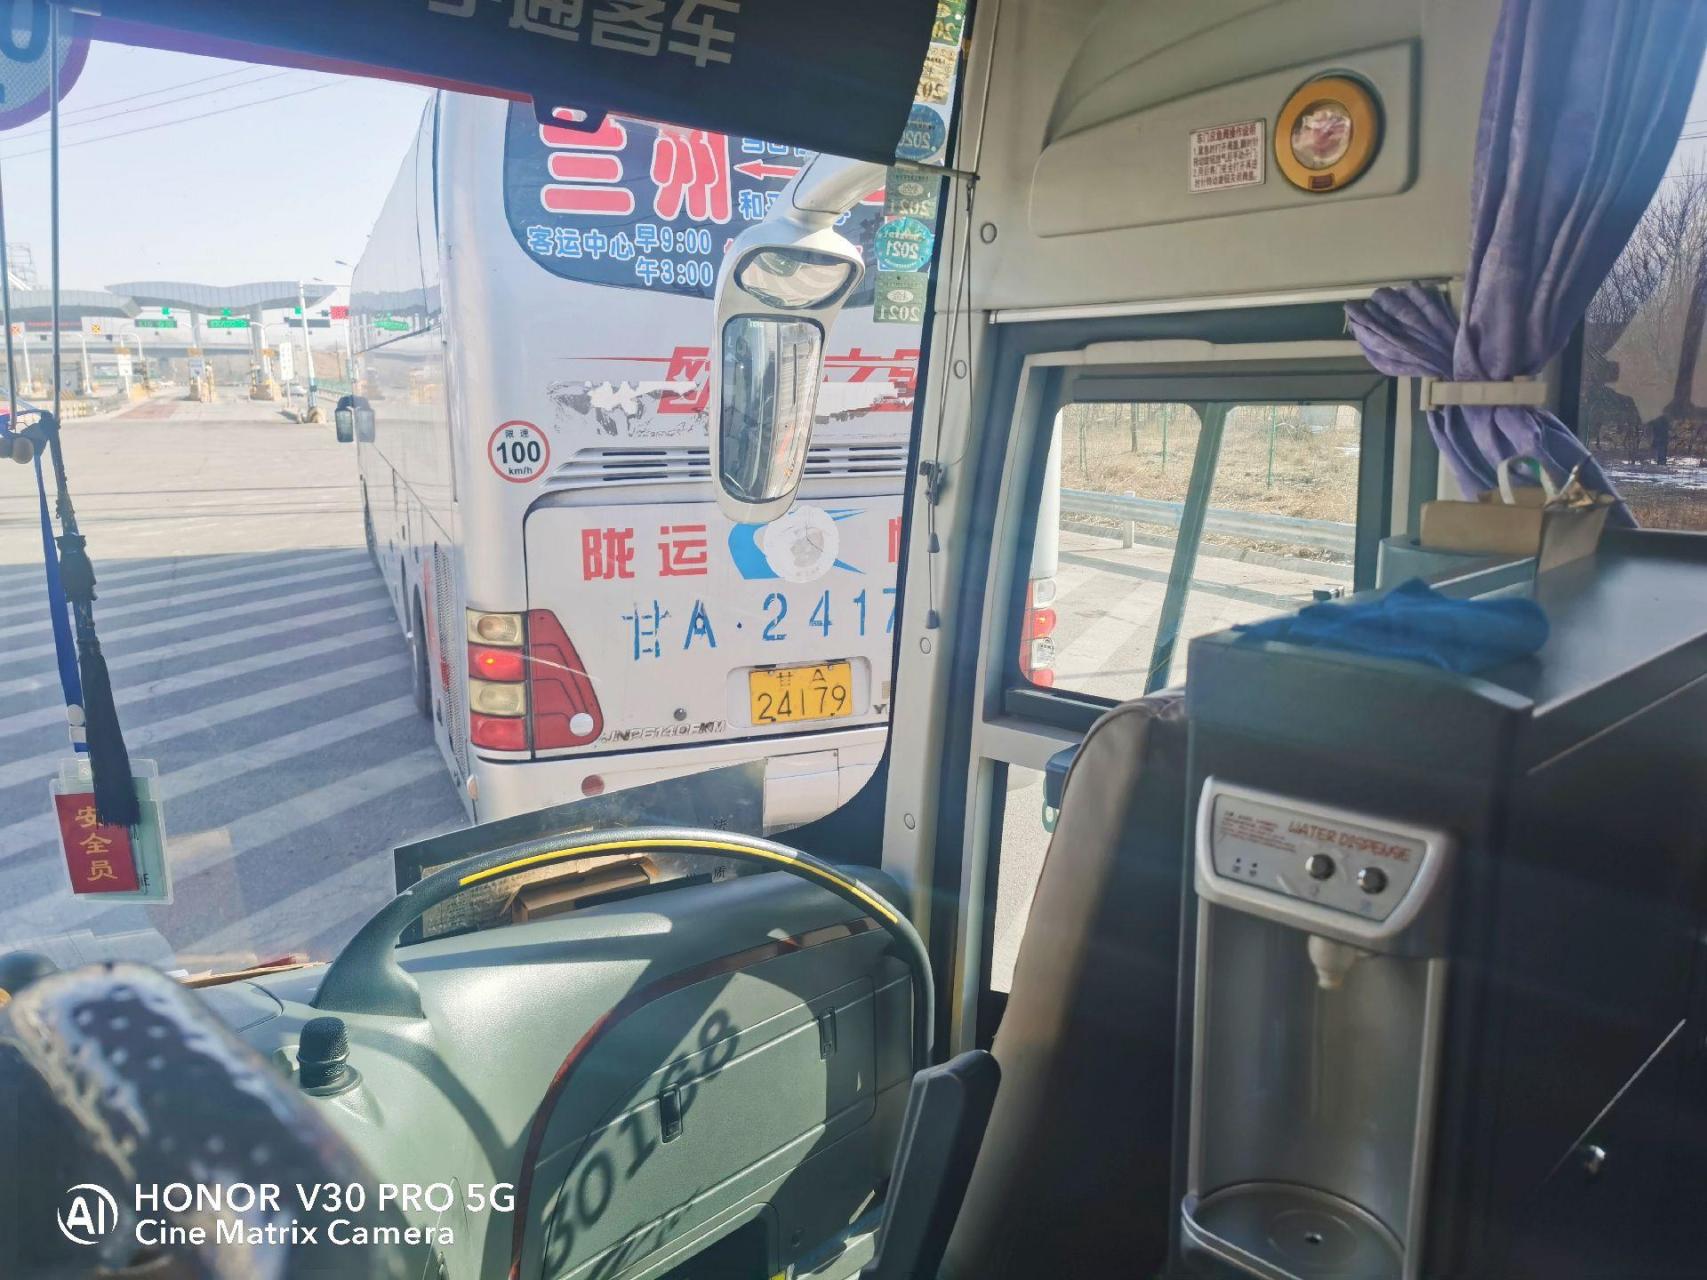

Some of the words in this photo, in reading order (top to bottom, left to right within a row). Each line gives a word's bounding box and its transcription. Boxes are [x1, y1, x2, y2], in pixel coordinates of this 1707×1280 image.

[635, 257, 714, 287] 午3:00
[496, 440, 541, 464] 100
[508, 466, 533, 475] km/h
[757, 684, 847, 724] 24179
[74, 805, 118, 882] 安全员
[1289, 821, 1337, 842] WATER
